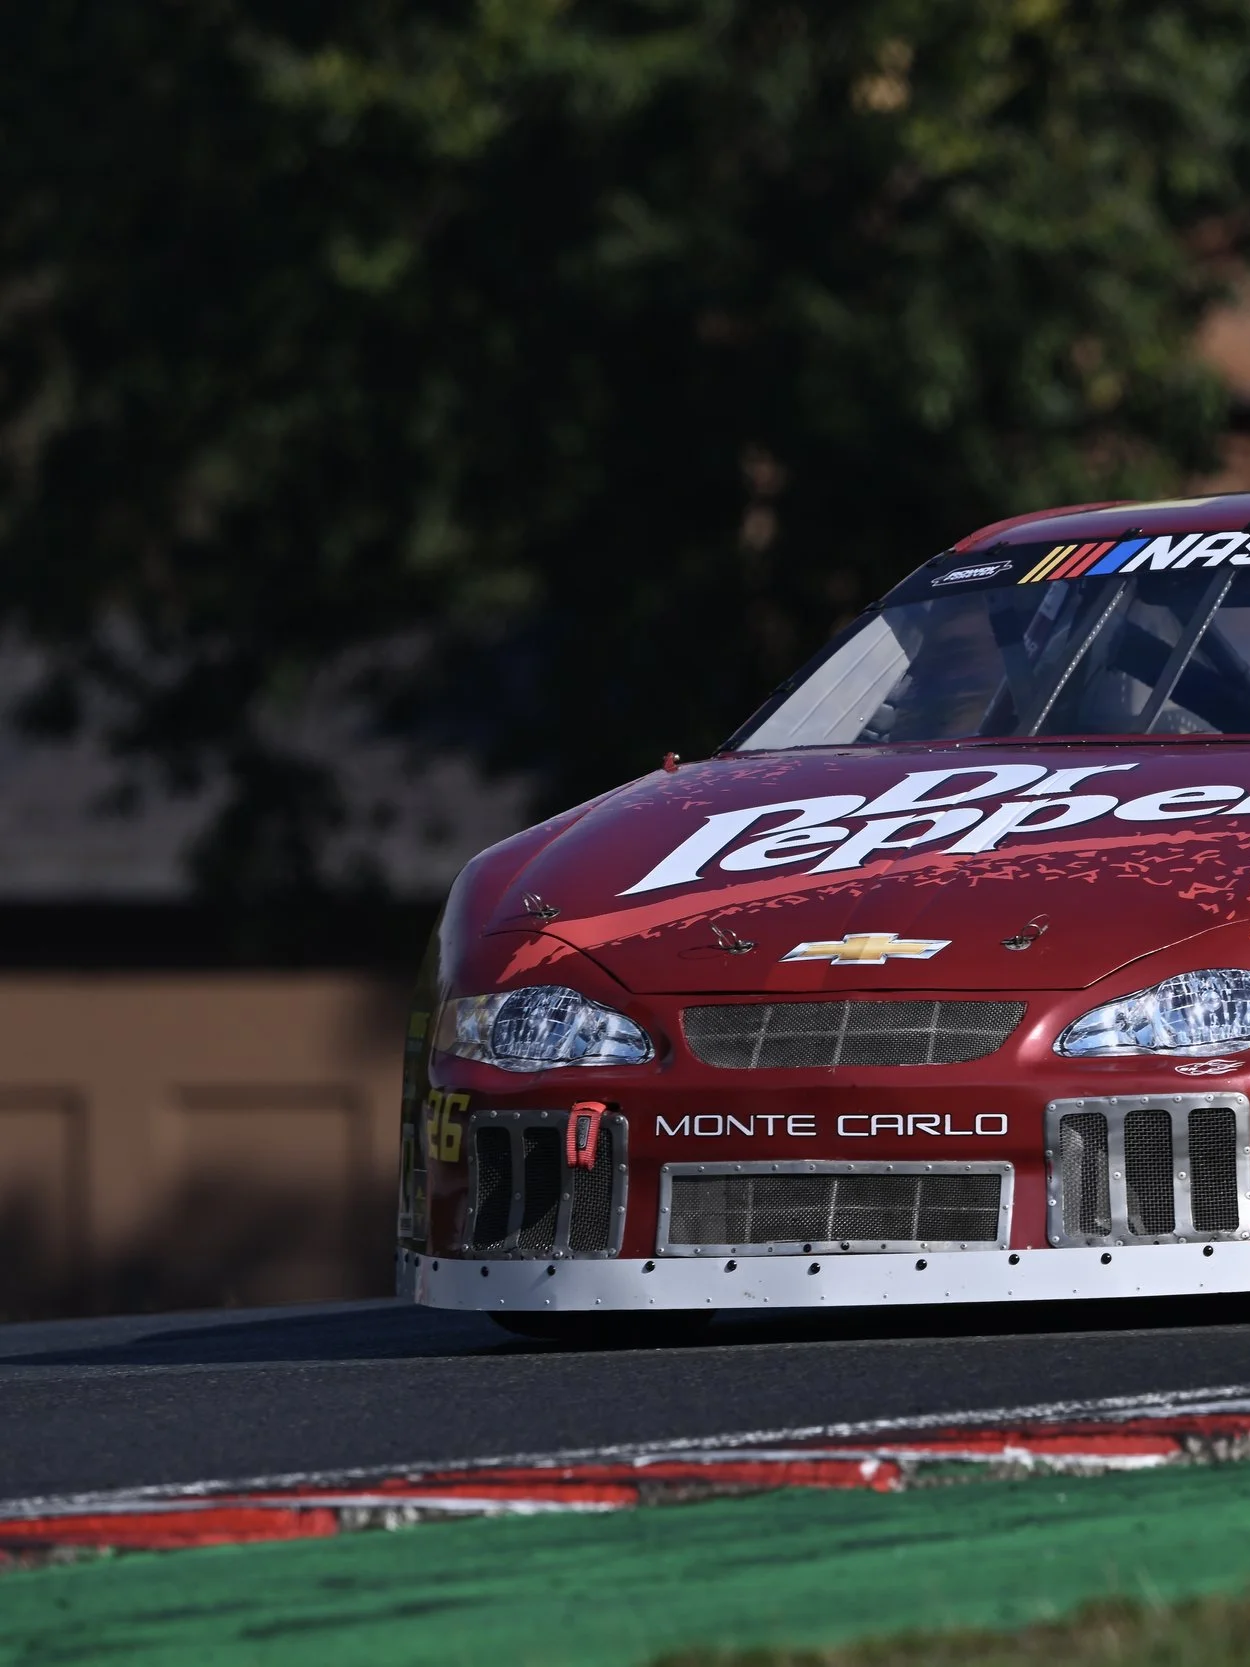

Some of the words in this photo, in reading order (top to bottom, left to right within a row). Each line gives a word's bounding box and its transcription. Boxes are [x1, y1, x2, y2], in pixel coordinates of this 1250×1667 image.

[866, 764, 1140, 818] Dr
[426, 1088, 471, 1164] 26
[656, 1114, 817, 1137] MONTE
[837, 1113, 1009, 1137] CARLO
